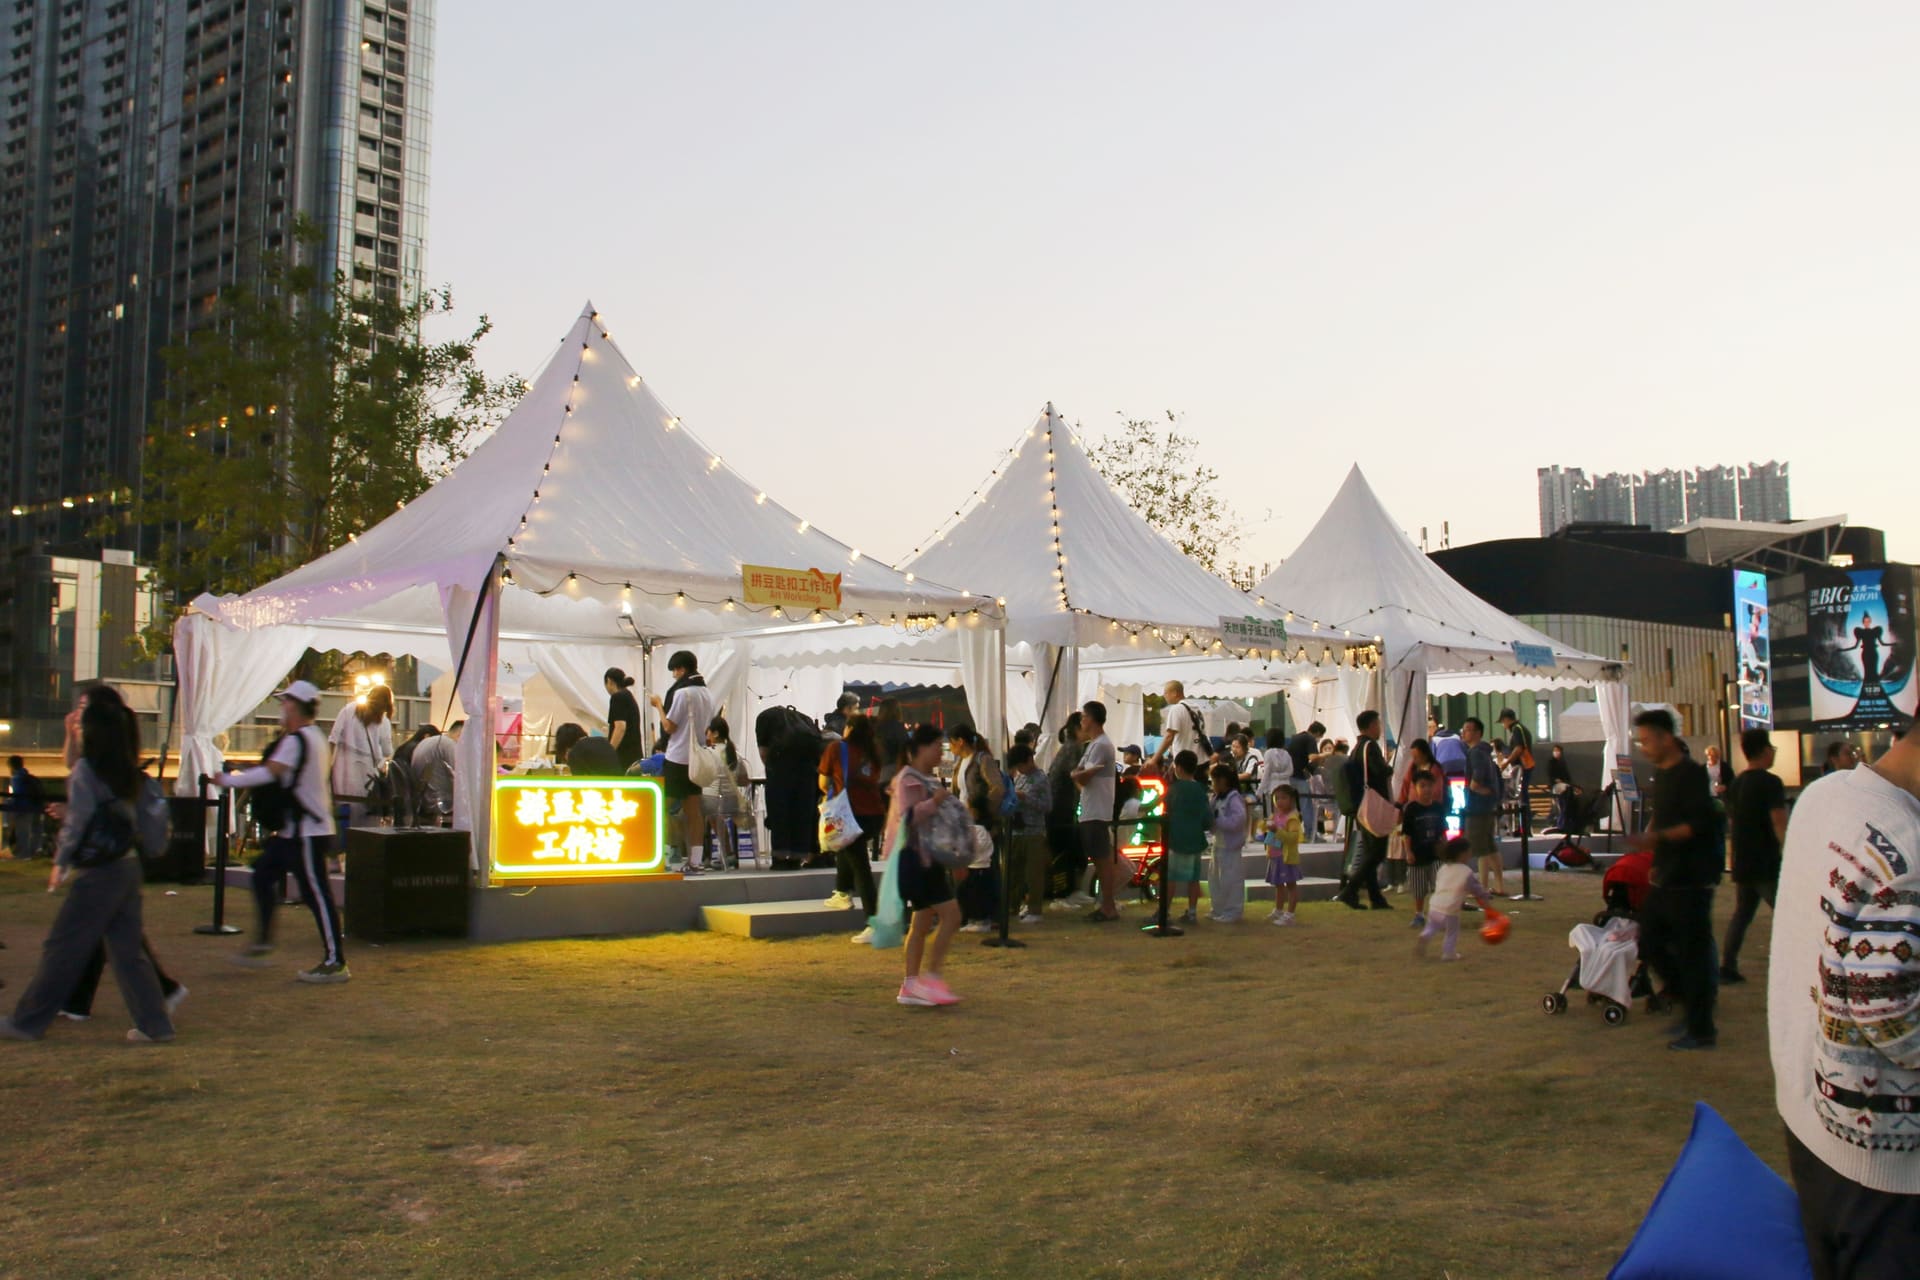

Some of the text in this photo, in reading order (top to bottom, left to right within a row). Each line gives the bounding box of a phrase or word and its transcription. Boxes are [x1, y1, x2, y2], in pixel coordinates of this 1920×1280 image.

[751, 572, 832, 595] 拼豆匙扣工作坊
[1820, 585, 1850, 605] BIG
